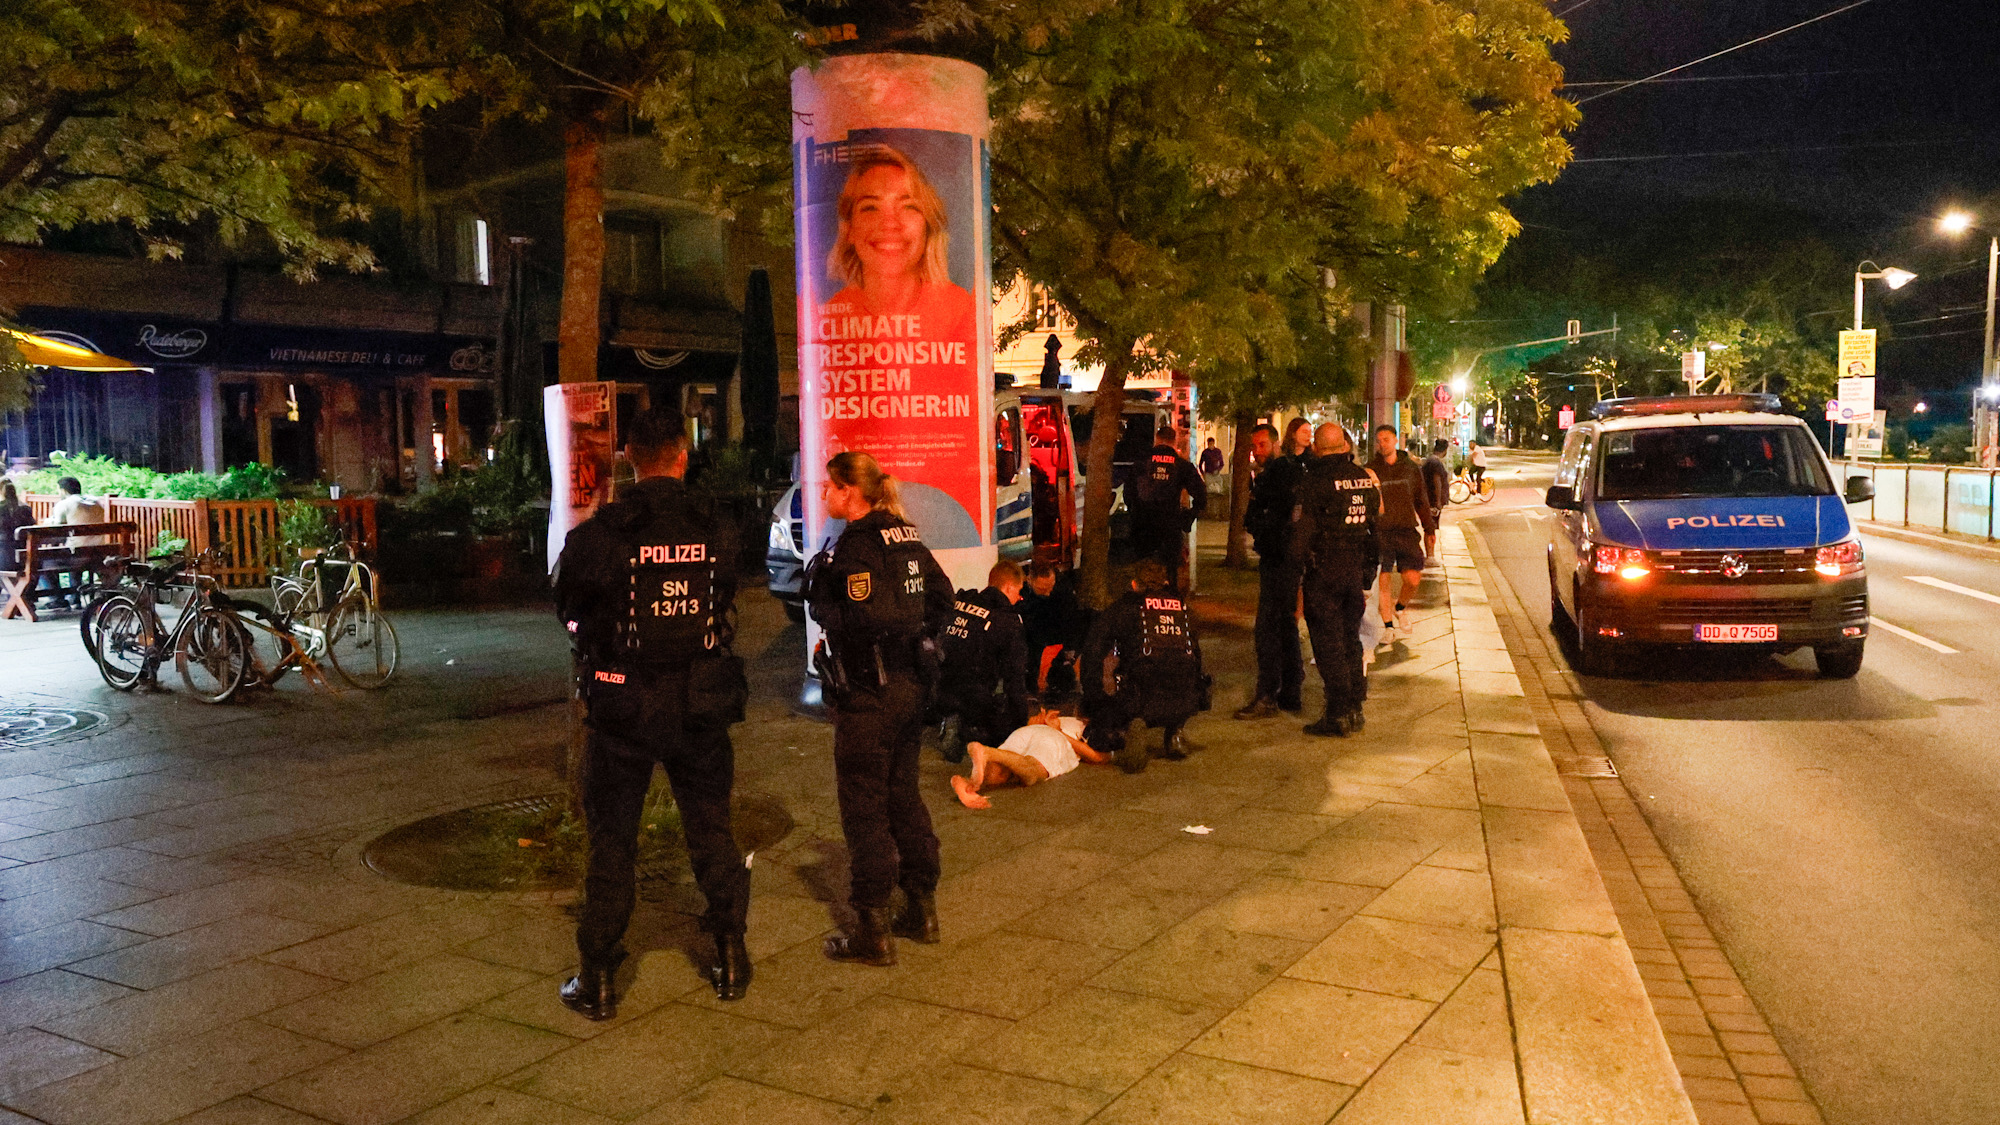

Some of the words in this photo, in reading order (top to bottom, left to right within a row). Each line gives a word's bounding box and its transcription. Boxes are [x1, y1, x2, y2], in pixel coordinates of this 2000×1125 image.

[818, 303, 852, 315] WERDE
[818, 315, 921, 340] CLIMATE
[135, 324, 206, 356] Radeberger
[269, 348, 348, 363] VIETNAMESE
[351, 352, 377, 364] DELI
[383, 353, 391, 364] &
[819, 341, 966, 367] RESPONSIVE
[820, 368, 911, 393] SYSTEM
[820, 395, 970, 420] DESIGNER:IN
[1152, 454, 1175, 464] POLIZEI
[1334, 478, 1373, 491] POLIZEI
[1352, 494, 1364, 505] SN
[1348, 505, 1366, 515] 13/10
[1667, 514, 1786, 530] POLIZEI
[880, 526, 921, 546] POLIZE
[640, 544, 706, 564] POLIZEI
[908, 560, 920, 576] SN
[662, 580, 689, 597] SN
[904, 578, 924, 595] 13/12
[651, 599, 700, 617] 13/13
[954, 600, 990, 620] OLIZEI
[1145, 598, 1182, 611] POLIZEI
[954, 616, 968, 628] SN
[1159, 615, 1175, 625] SN
[946, 625, 969, 639] 13/13
[1154, 625, 1182, 635] 13/13
[1703, 626, 1721, 638] DD
[1729, 626, 1738, 639] Q
[1742, 626, 1775, 639] 7505
[595, 671, 626, 684] POLIZEI
